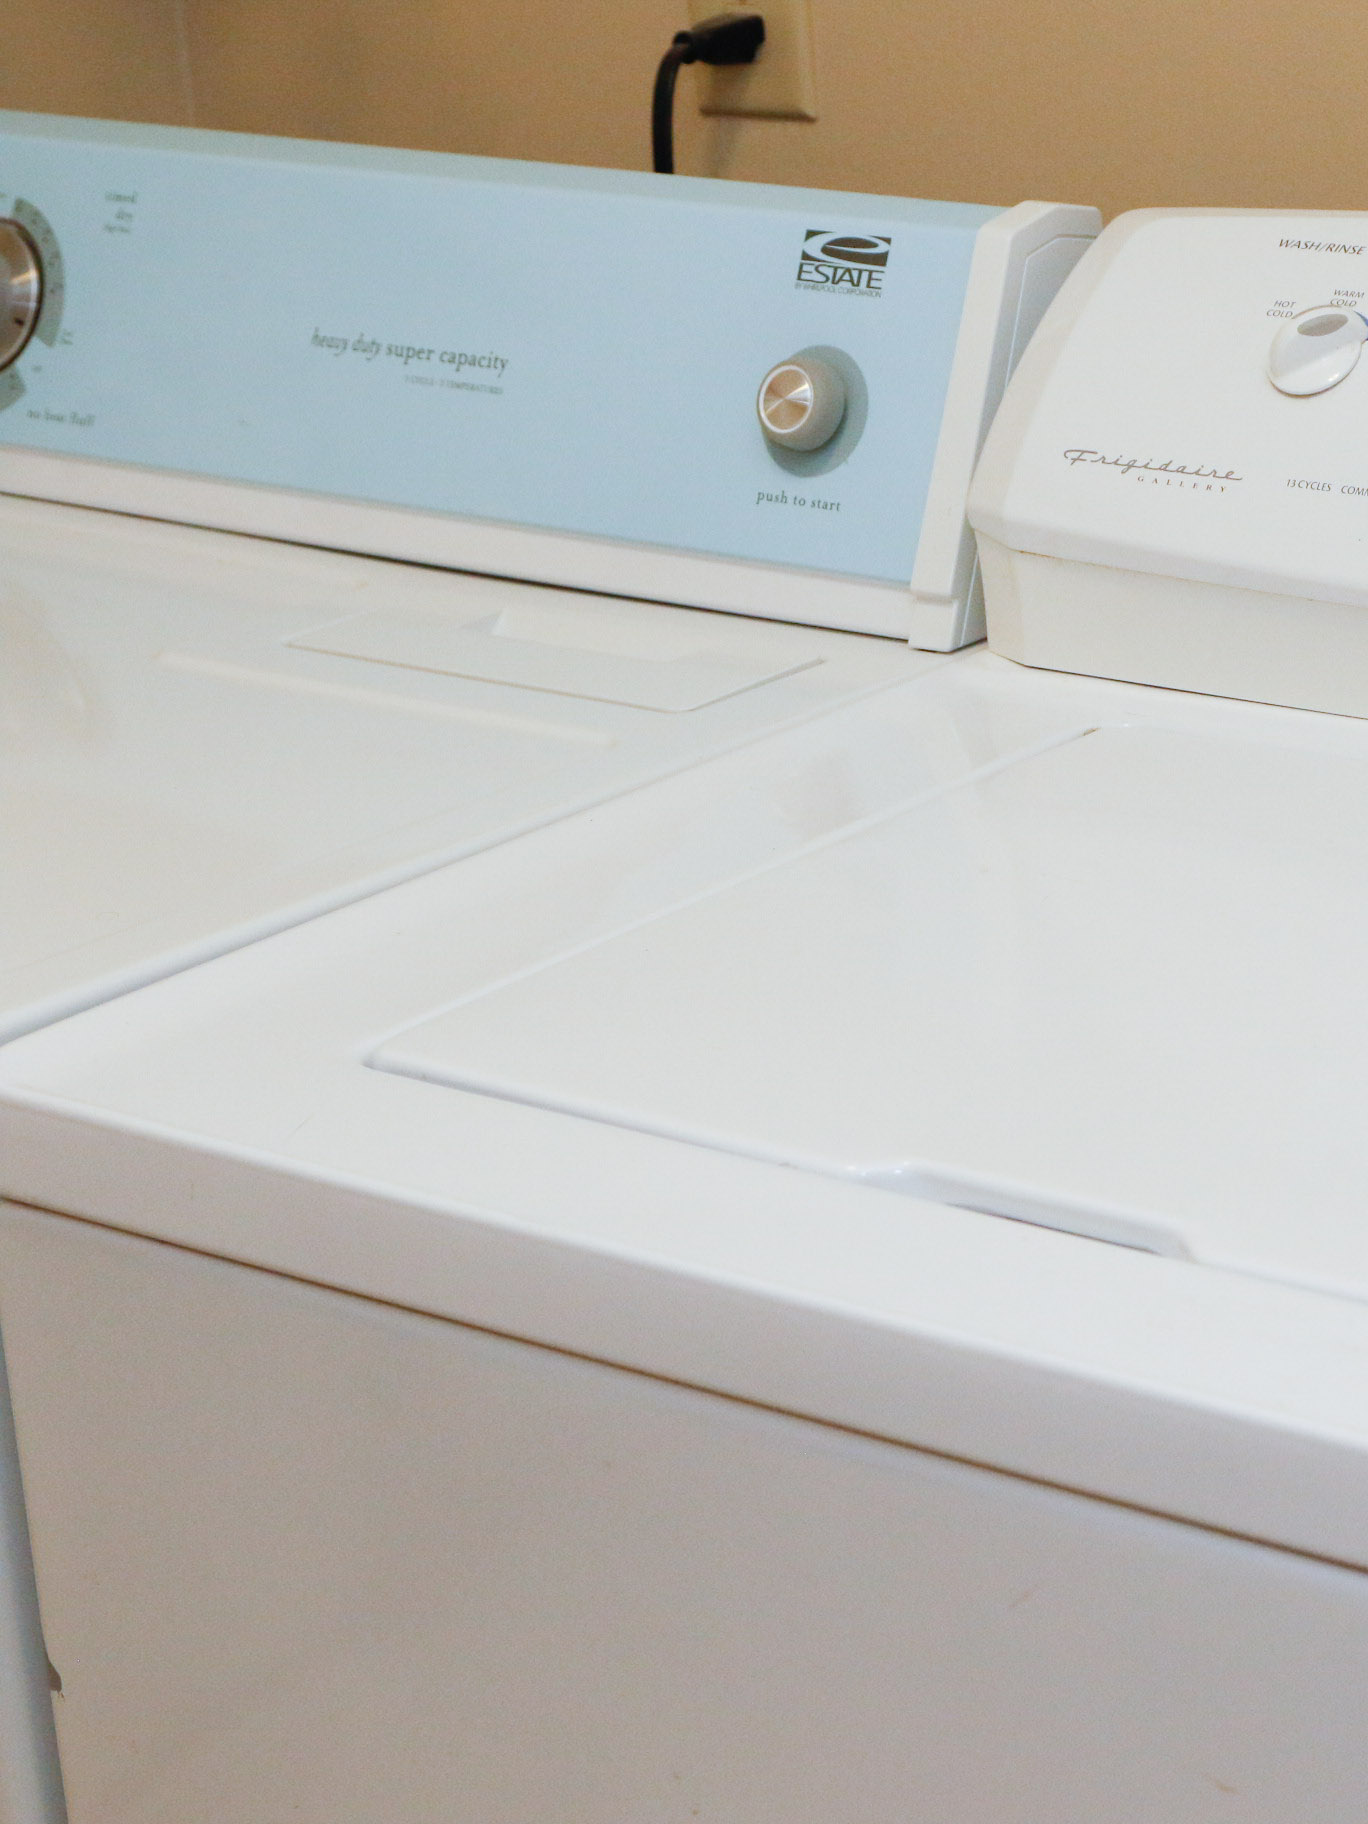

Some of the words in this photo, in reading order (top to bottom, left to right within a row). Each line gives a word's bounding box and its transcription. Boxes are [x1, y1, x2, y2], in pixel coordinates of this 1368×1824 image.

[1278, 238, 1366, 256] WASH/RINSE
[796, 262, 885, 290] ESTATE
[1334, 290, 1364, 299] WARM
[1274, 300, 1296, 308] HOT
[1330, 299, 1357, 307] COLD
[1266, 309, 1293, 318] COLD
[386, 344, 435, 365] super
[439, 350, 508, 378] capacity
[1064, 450, 1242, 480] Frigidaire
[1138, 476, 1226, 492] GALLERY
[1298, 480, 1332, 492] CYCLES
[757, 490, 788, 504] push
[793, 494, 806, 507] to
[810, 498, 840, 511] start
